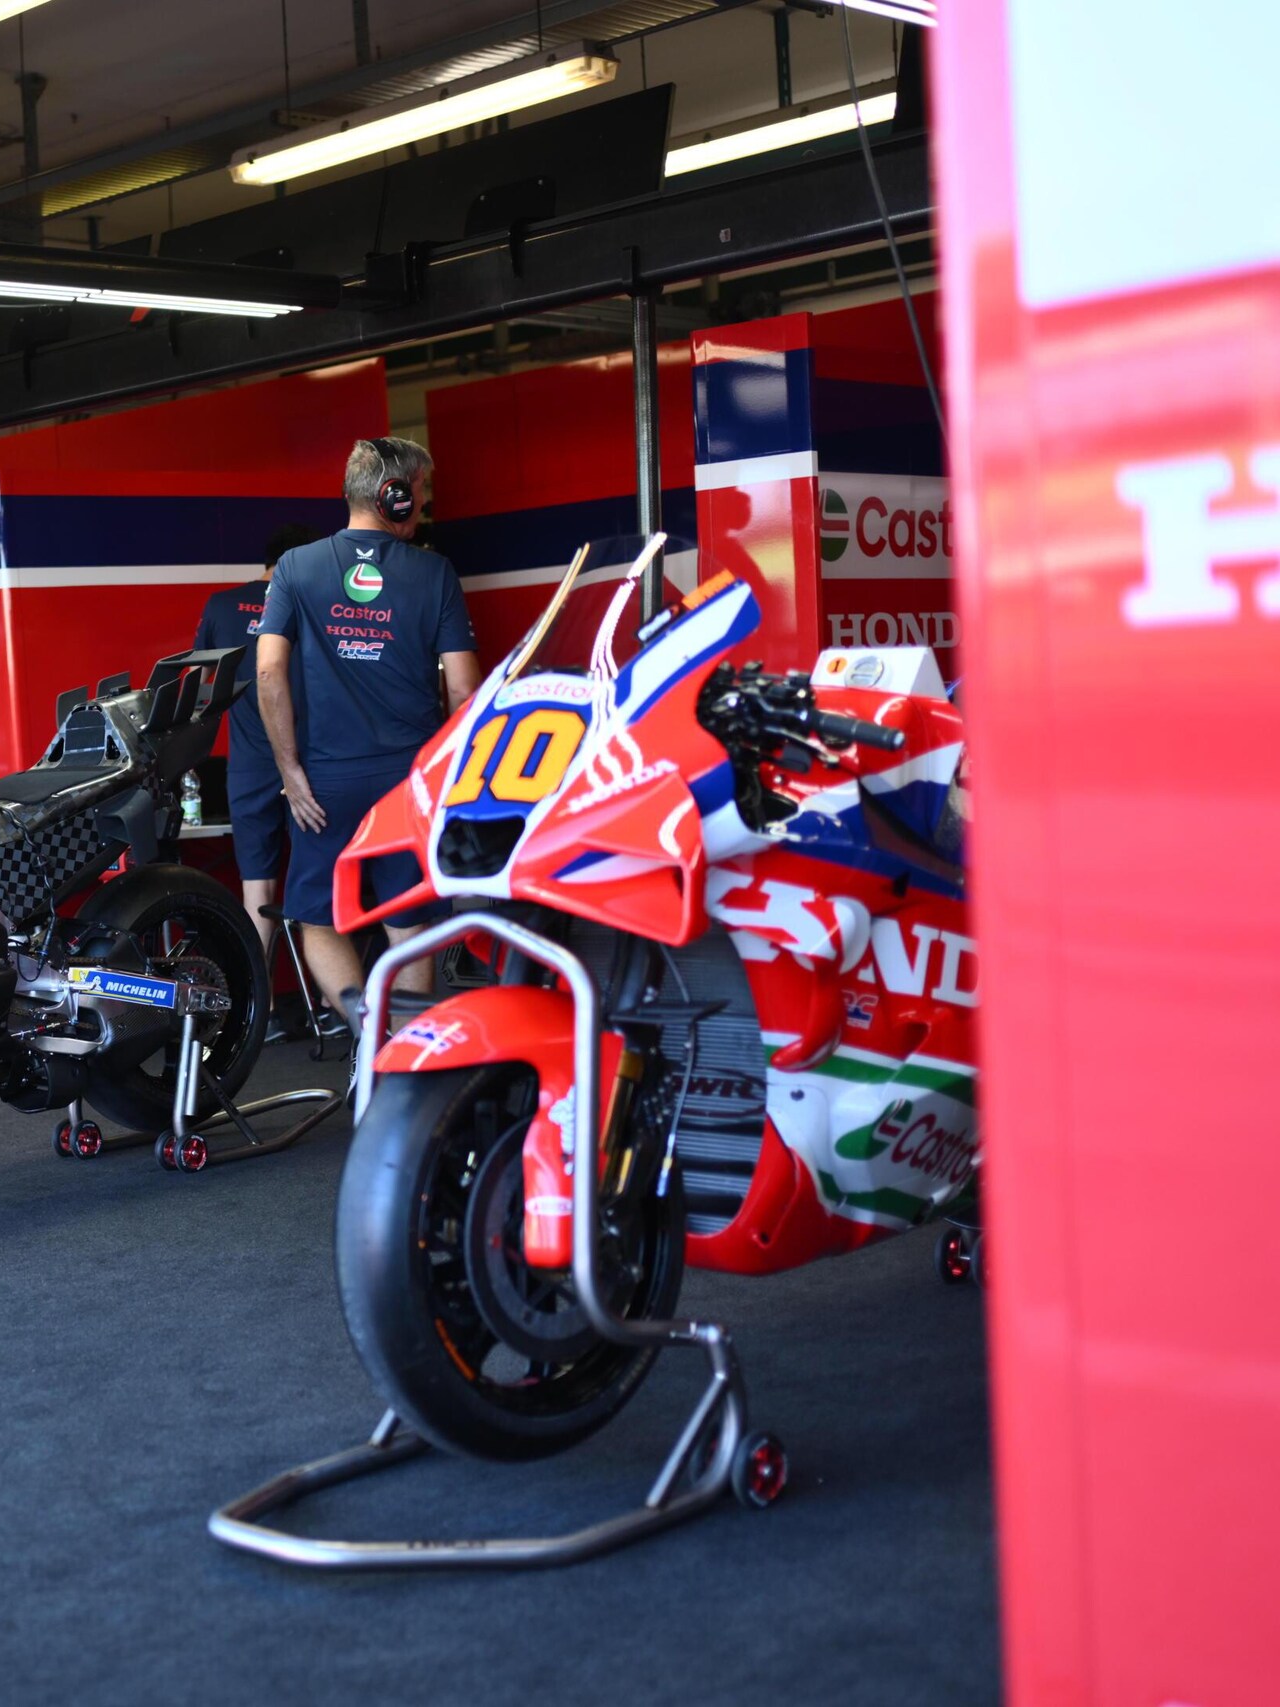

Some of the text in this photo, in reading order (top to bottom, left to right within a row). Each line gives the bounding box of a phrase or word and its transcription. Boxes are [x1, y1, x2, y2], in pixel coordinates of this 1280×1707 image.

[331, 604, 392, 623] Castrol
[326, 625, 394, 640] HONDA
[337, 640, 384, 657] HRC
[444, 709, 586, 806] 10
[105, 981, 167, 1000] MICHELIN
